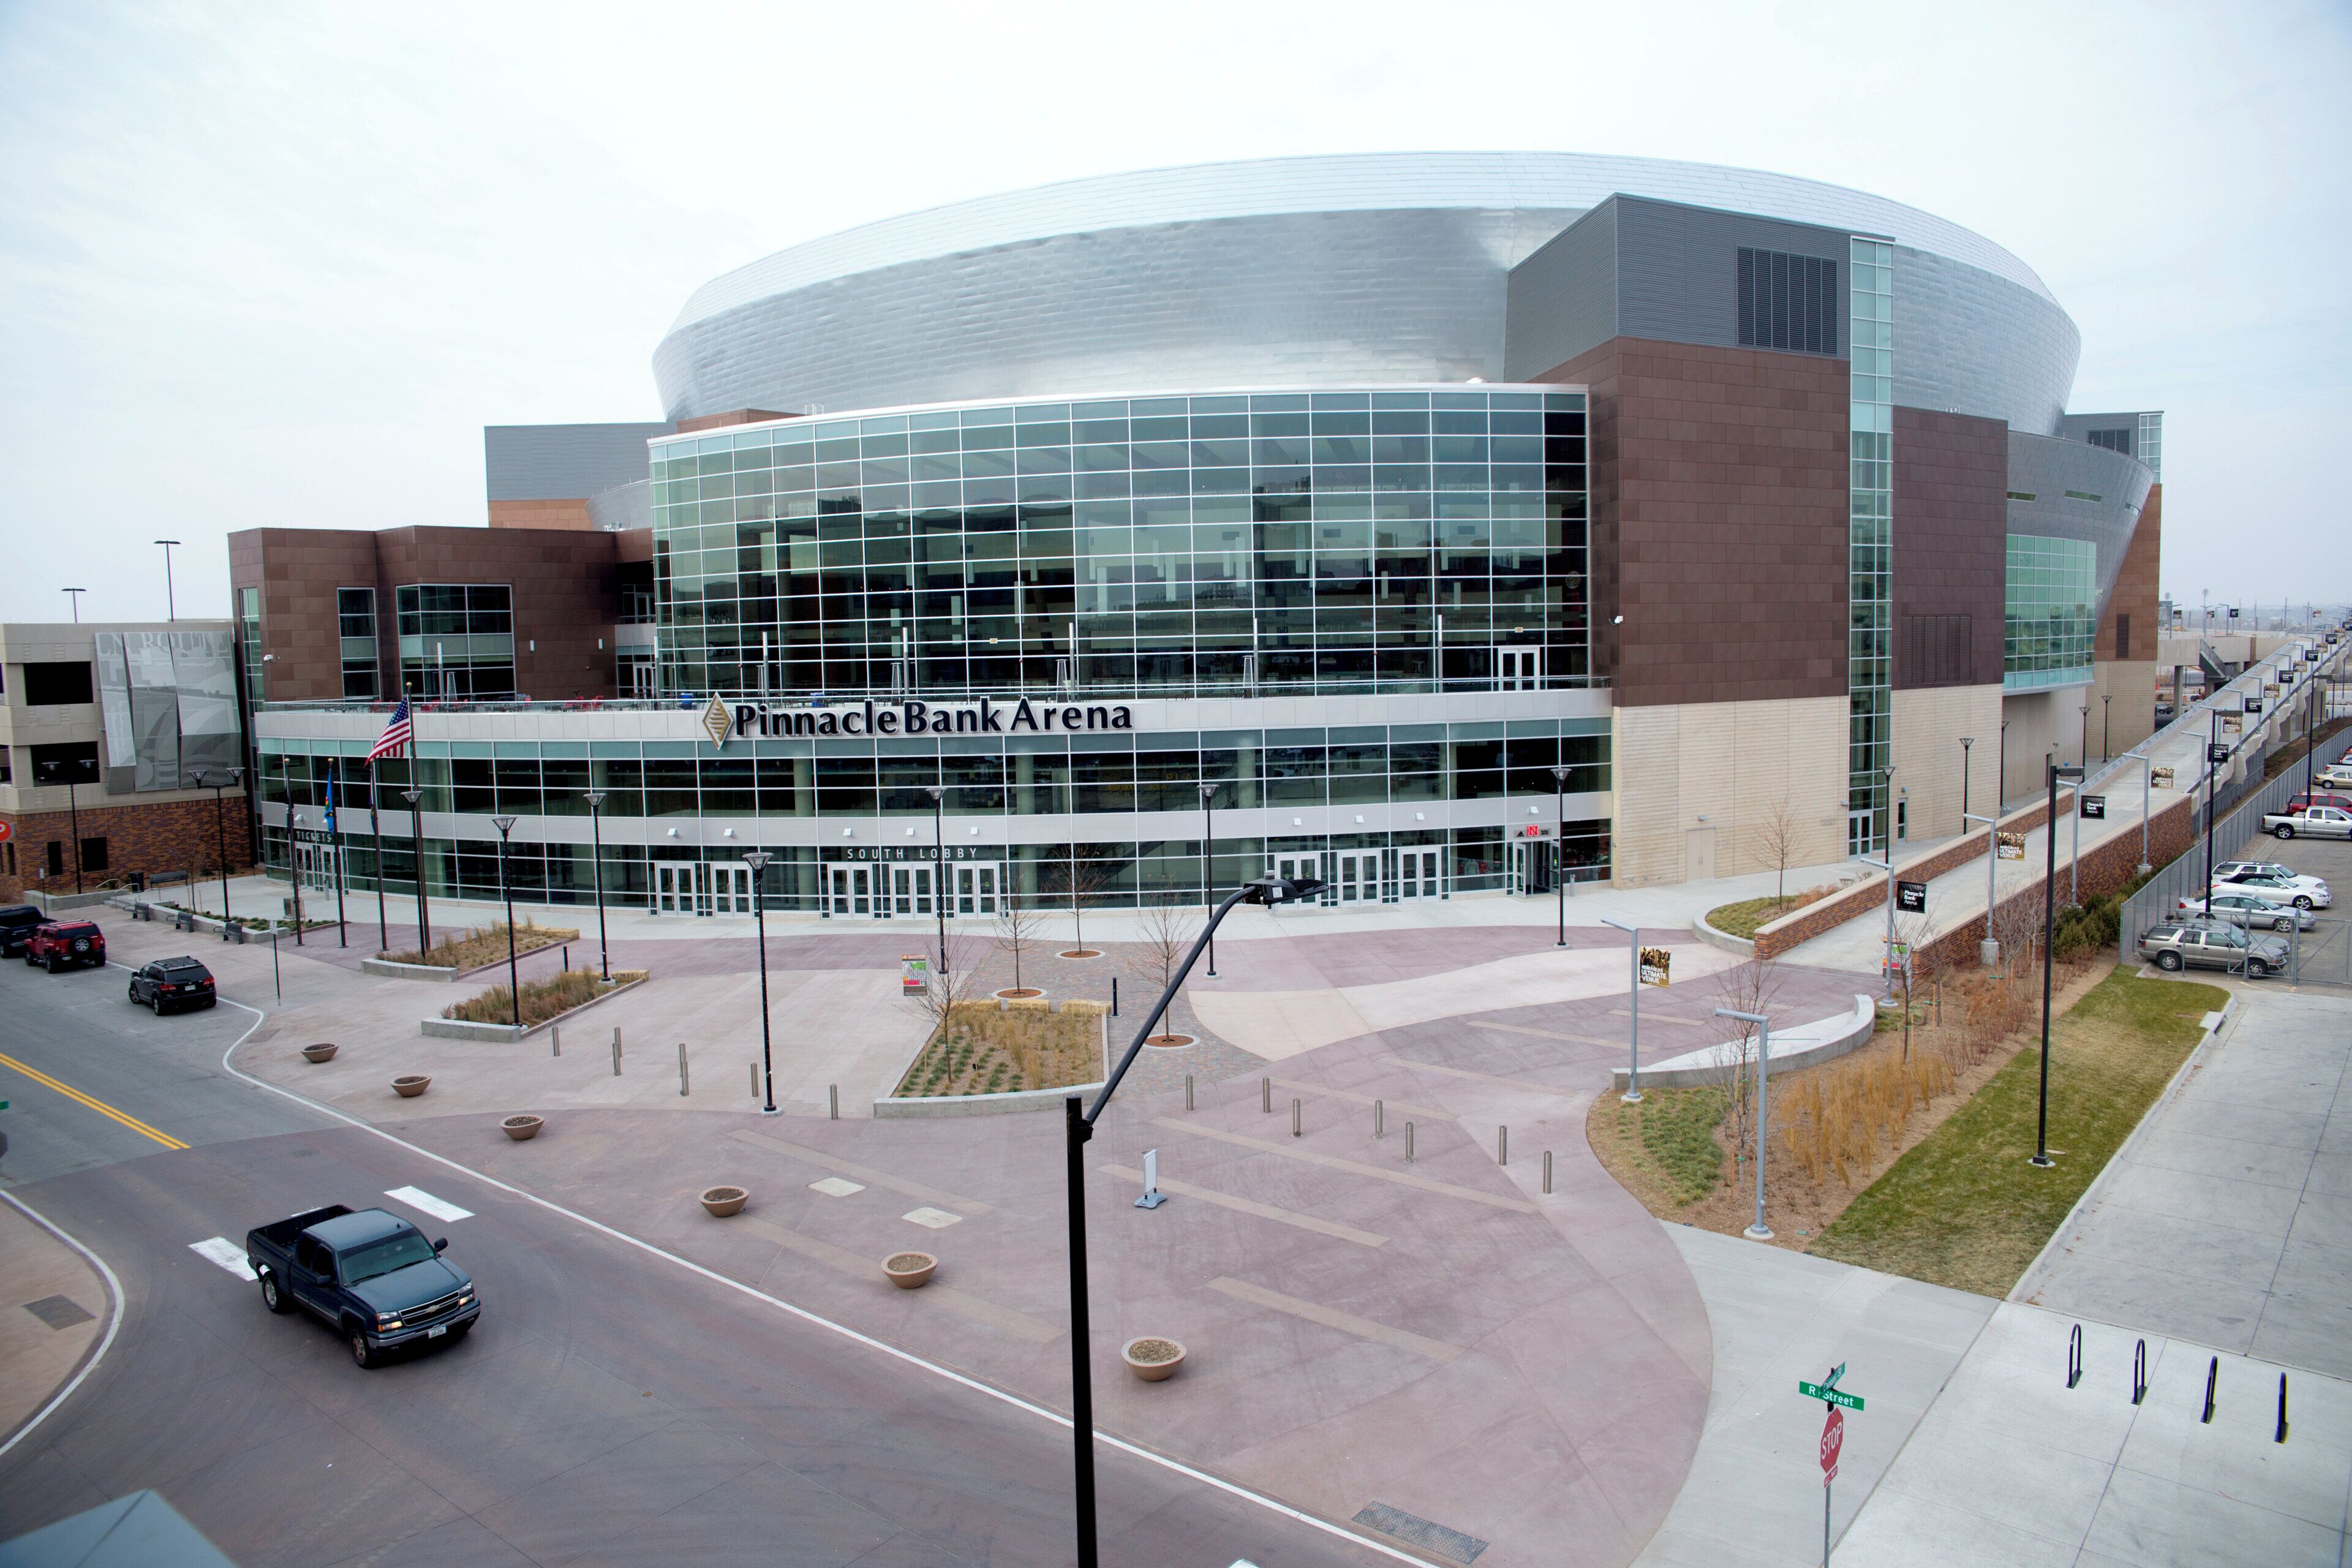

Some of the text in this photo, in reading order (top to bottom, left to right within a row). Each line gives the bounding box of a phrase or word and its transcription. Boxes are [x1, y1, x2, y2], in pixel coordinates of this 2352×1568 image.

[735, 695, 1133, 736] Pinnacle Bank Arena
[296, 831, 332, 843] TICKETS
[1527, 825, 1539, 837] N
[847, 848, 977, 859] SOUTH LOBBY
[1642, 968, 1667, 979] ULTIMATE
[1642, 974, 1660, 984] VENUE
[1809, 1385, 1854, 1407] R Street
[1821, 1421, 1842, 1460] STOP
